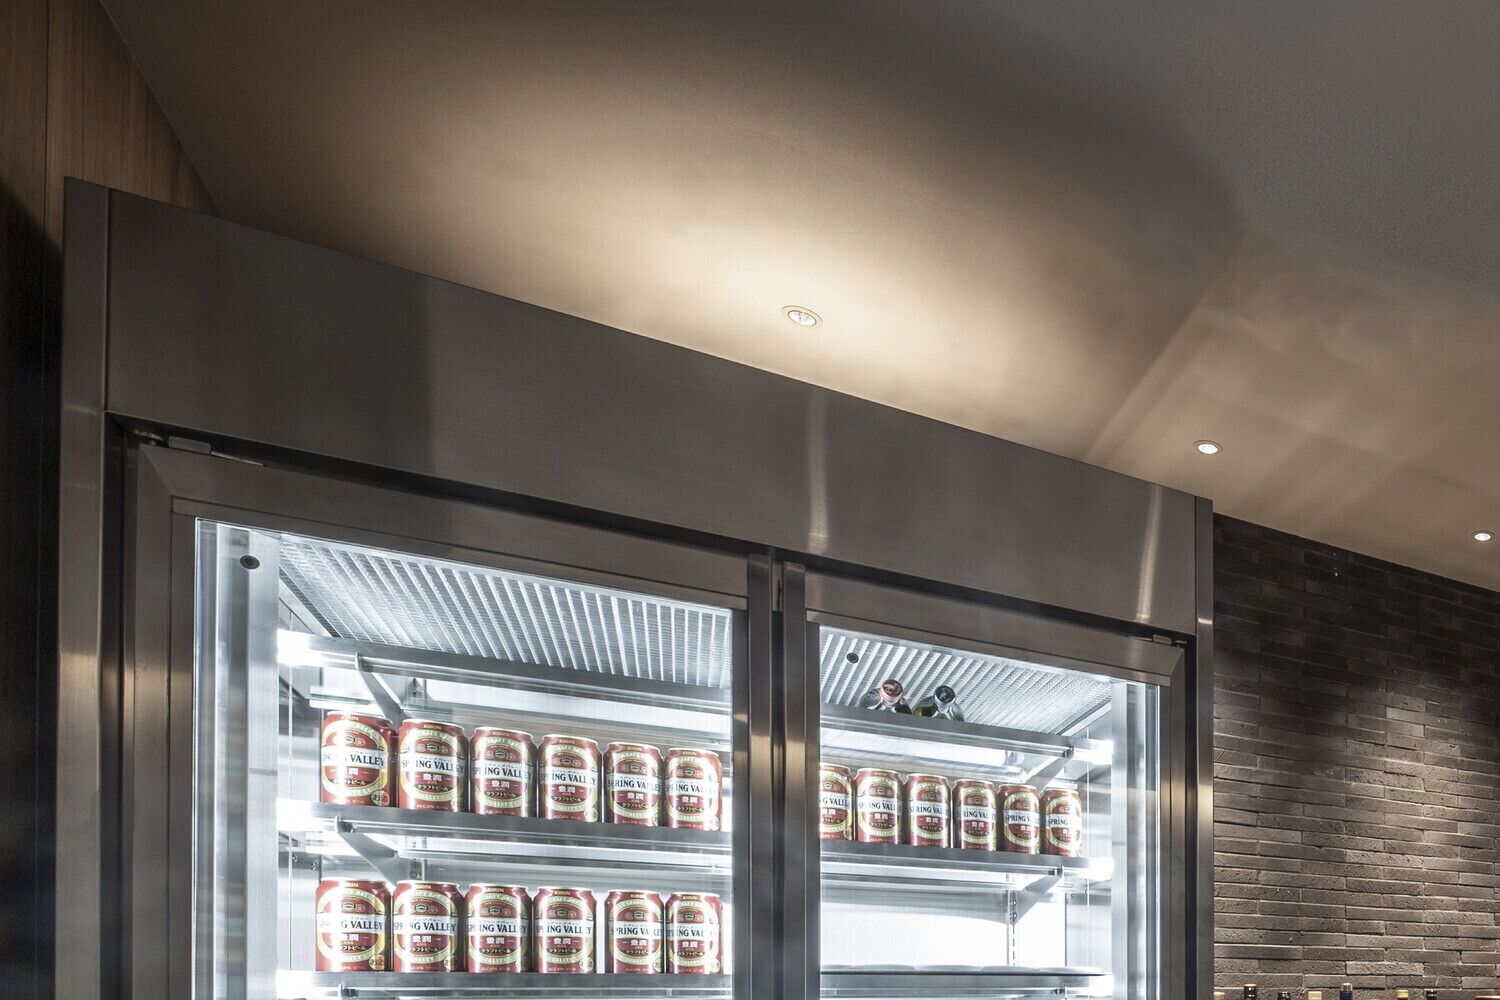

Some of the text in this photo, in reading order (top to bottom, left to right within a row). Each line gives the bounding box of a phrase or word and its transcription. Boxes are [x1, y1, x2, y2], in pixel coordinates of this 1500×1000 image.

[350, 754, 384, 767] VALLEY
[351, 920, 383, 930] VALLEY
[424, 922, 456, 931] VALLEY
